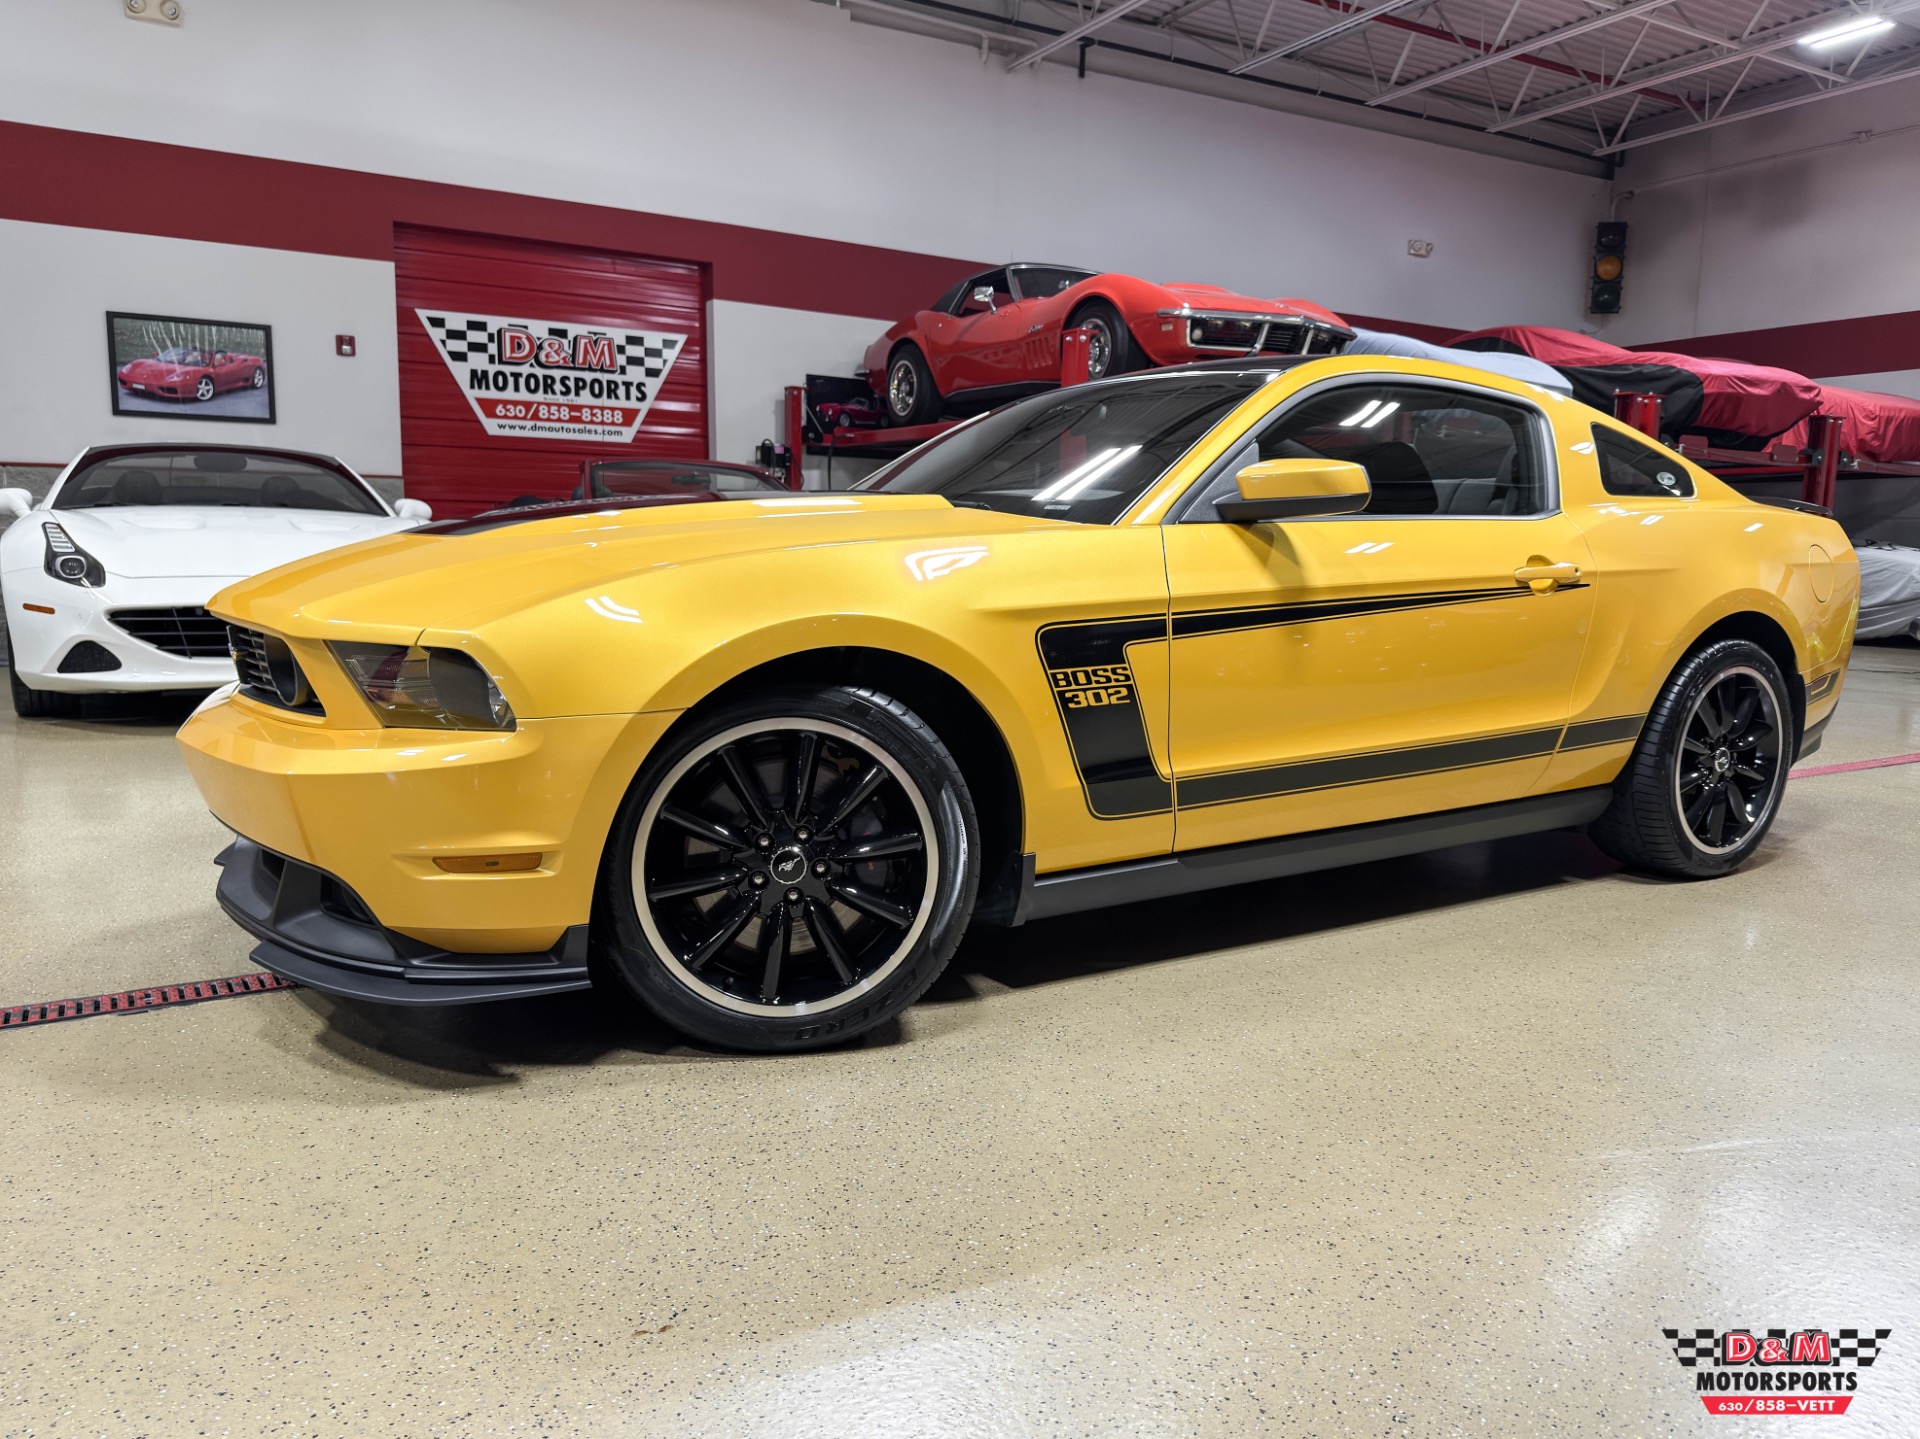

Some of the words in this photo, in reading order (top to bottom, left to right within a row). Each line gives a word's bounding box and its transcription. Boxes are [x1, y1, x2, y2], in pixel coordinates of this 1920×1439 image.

[498, 328, 618, 374] D&M
[469, 369, 648, 402] MOTORSPORTS
[496, 403, 623, 424] 630/858-8388
[497, 423, 623, 437] www.dmautosales.com
[1051, 667, 1131, 688] BOSS
[1064, 687, 1131, 709] 302
